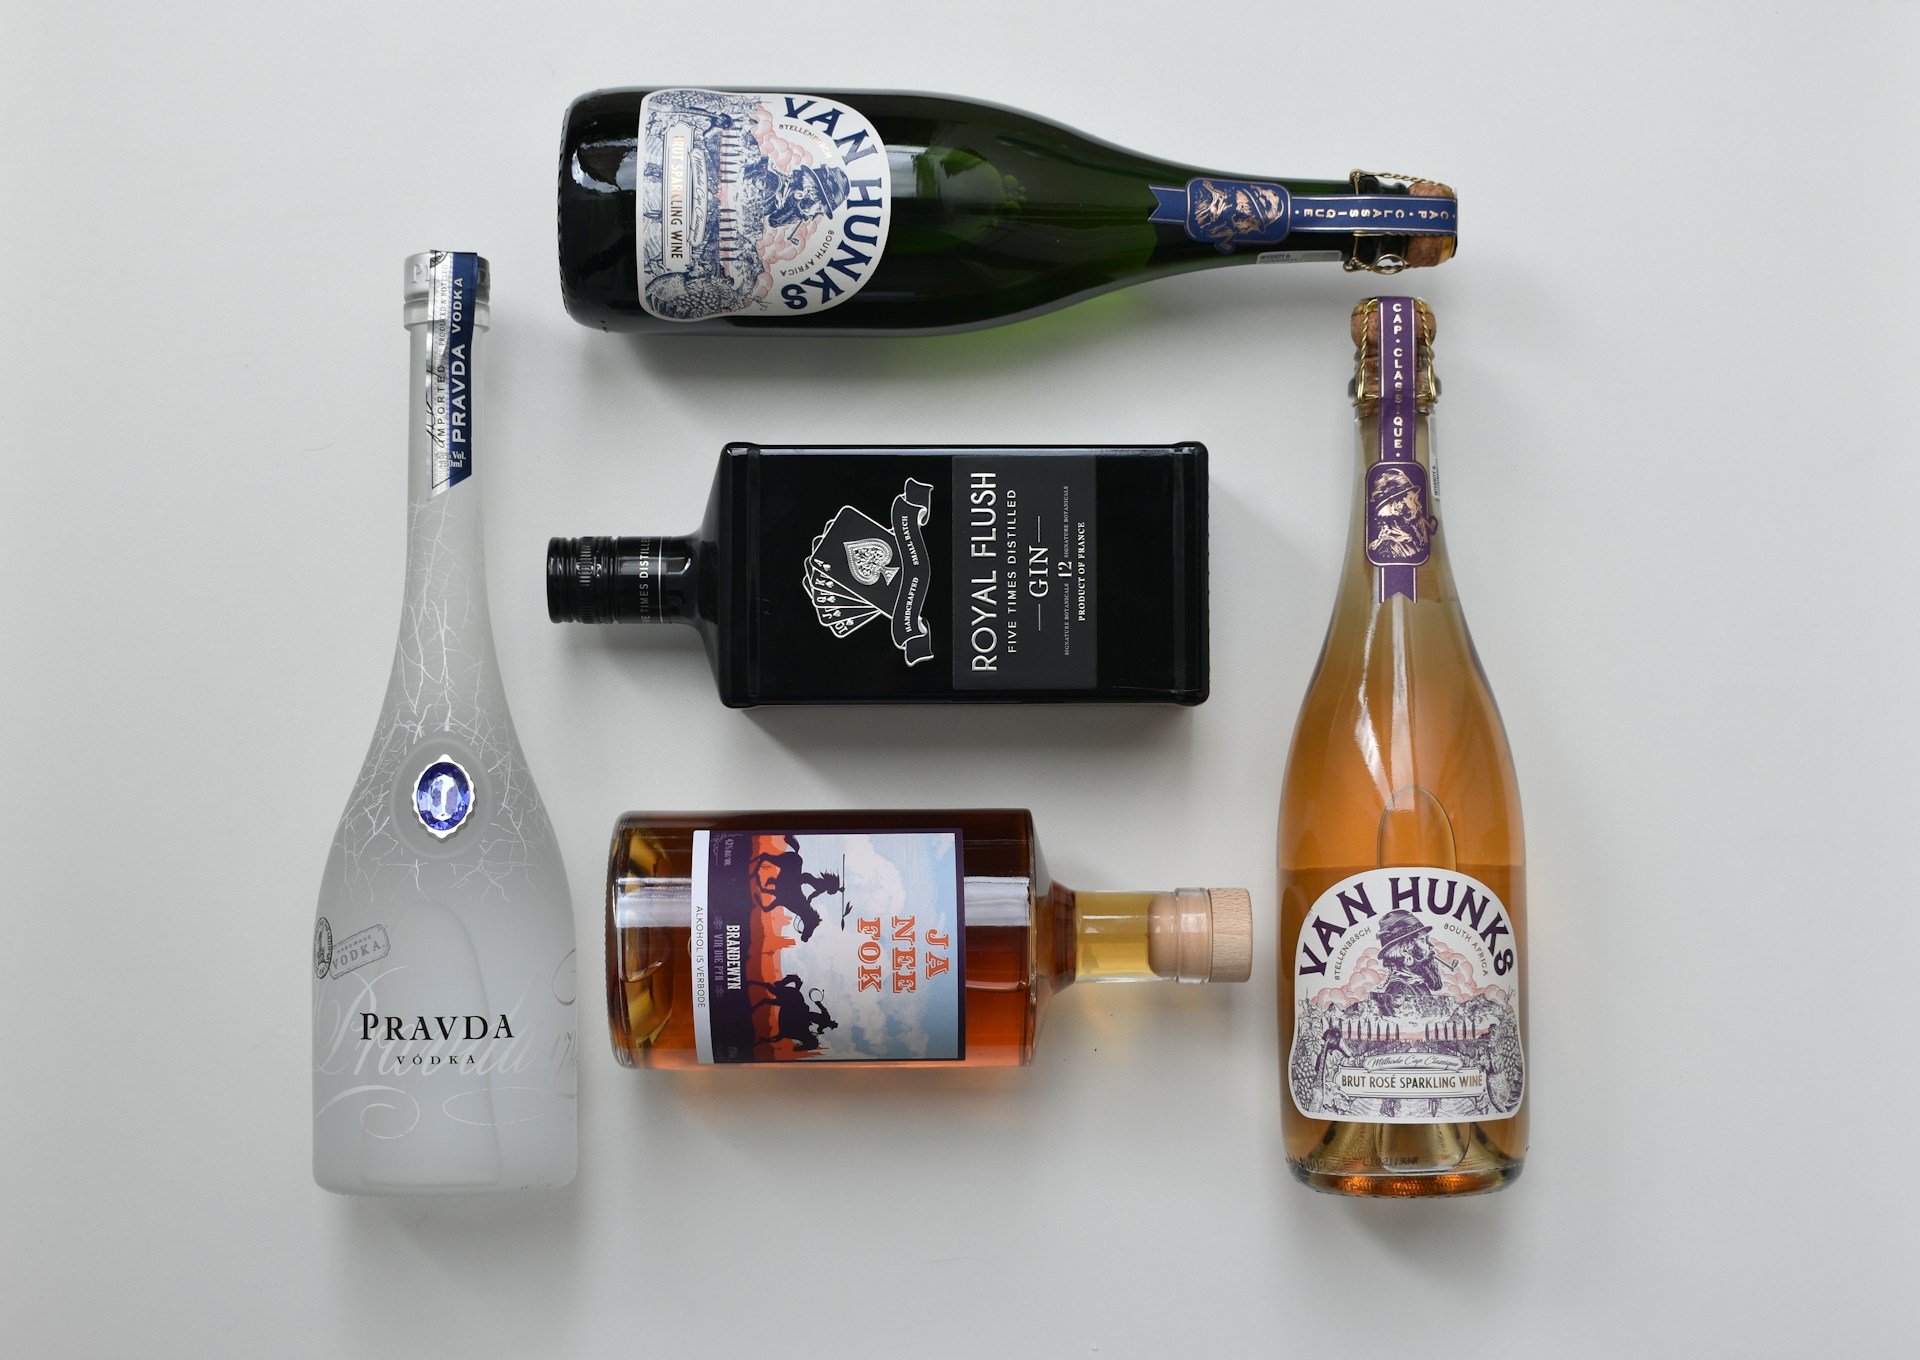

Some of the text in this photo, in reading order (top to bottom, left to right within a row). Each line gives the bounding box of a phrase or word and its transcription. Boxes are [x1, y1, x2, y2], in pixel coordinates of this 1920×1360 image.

[671, 135, 685, 259] BRUT SPARKLING WINE
[780, 96, 884, 309] VAN HUNKS
[1303, 208, 1450, 220] CAP CLASSIQUE
[780, 229, 836, 277] SOUTH AFRICA
[1392, 303, 1403, 335] CAP
[451, 277, 466, 442] PRAVDA VODKA
[437, 365, 446, 444] IMPORTED
[813, 558, 824, 567] A
[815, 578, 826, 586] K
[901, 515, 919, 633] HANDCRAFTED SMALL BATCH
[970, 473, 998, 671] ROYAL FLUSH
[1006, 489, 1017, 653] FIVE TIMES DISTILLED
[1029, 545, 1049, 598] GIN
[1057, 561, 1073, 578] 12
[1077, 522, 1086, 621] PRODUCT OF FRANCE
[639, 584, 649, 612] TIMES
[835, 620, 848, 634] 10
[713, 933, 723, 948] VIR
[1299, 876, 1514, 977] VAN HUNKS
[1443, 922, 1489, 977] SOUTH AFRICA
[695, 906, 706, 1008] ALKOHOL IS VERBODE
[714, 950, 724, 963] DIE
[726, 925, 742, 990] BRANDEWYN
[857, 917, 882, 992] FOK
[891, 915, 916, 993] NEE
[925, 928, 949, 980] JA
[359, 1012, 515, 1041] PRAVDA
[396, 1053, 477, 1066] VÓDKA
[1341, 1074, 1483, 1088] BRUT ROSÉ SPARKLING WINE
[1405, 1055, 1423, 1067] Cap
[1424, 1055, 1460, 1070] Classique
